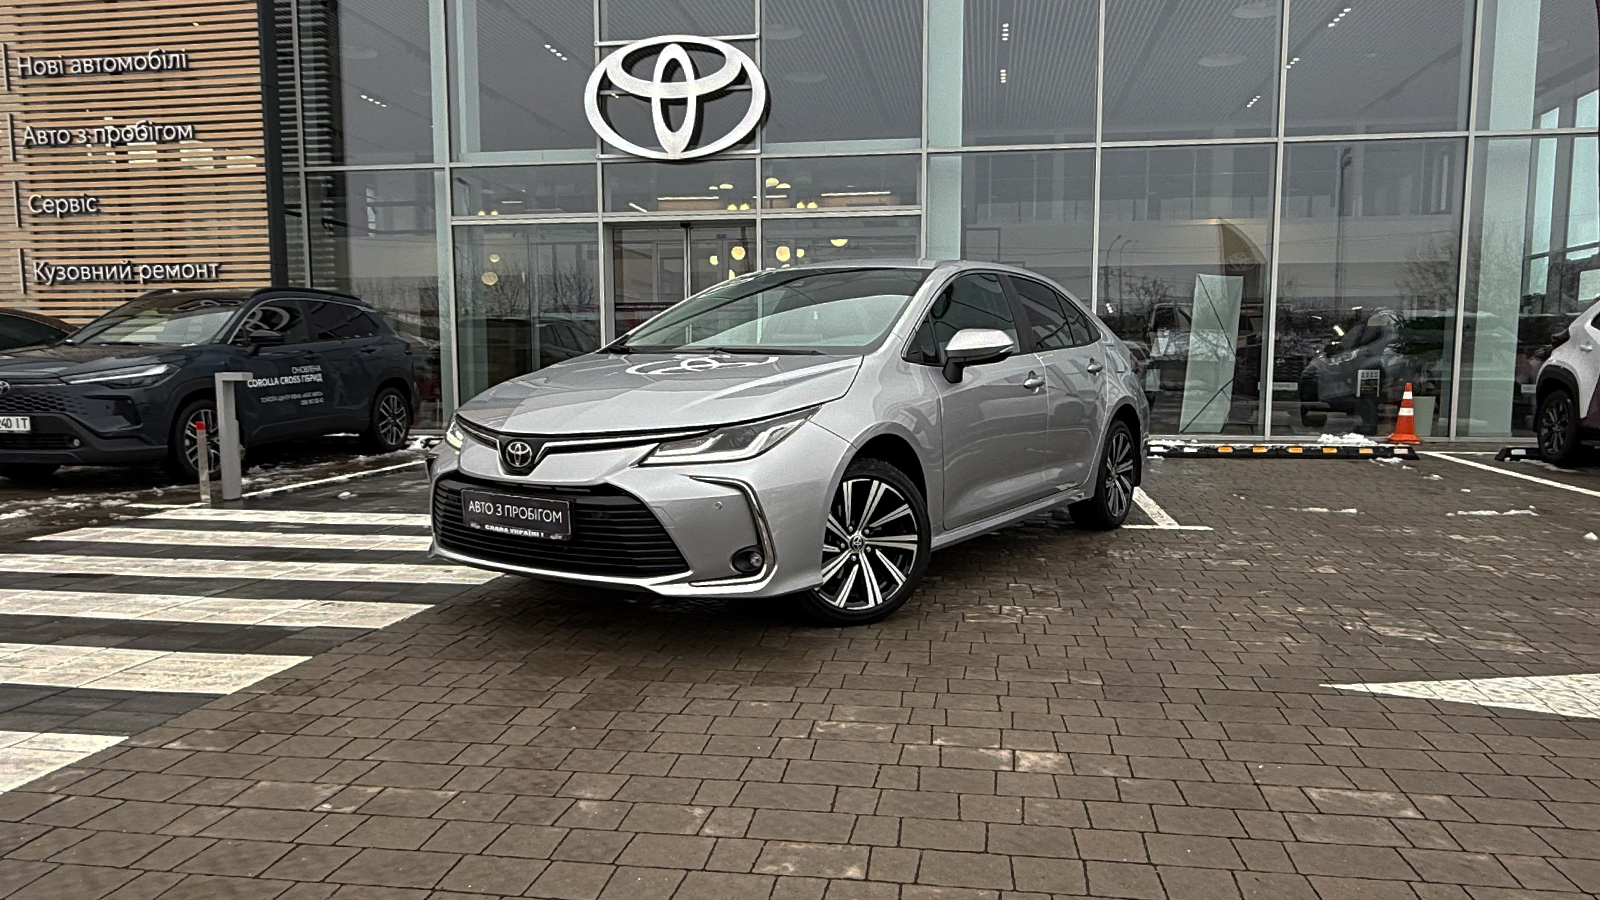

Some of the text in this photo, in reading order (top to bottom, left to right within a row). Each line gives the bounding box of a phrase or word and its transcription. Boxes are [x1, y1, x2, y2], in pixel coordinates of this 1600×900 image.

[17, 47, 189, 76] Нові автомобілі
[23, 120, 194, 147] Авто з пробігом
[28, 194, 98, 218] Сервіс
[33, 260, 220, 285] Кузовний ремонт
[248, 378, 279, 388] COROLLA
[280, 376, 301, 385] CROSS
[16, 418, 28, 429] IT
[468, 500, 563, 524] АВТО З ПРОБІГОМ
[484, 524, 509, 533] СЛАВА
